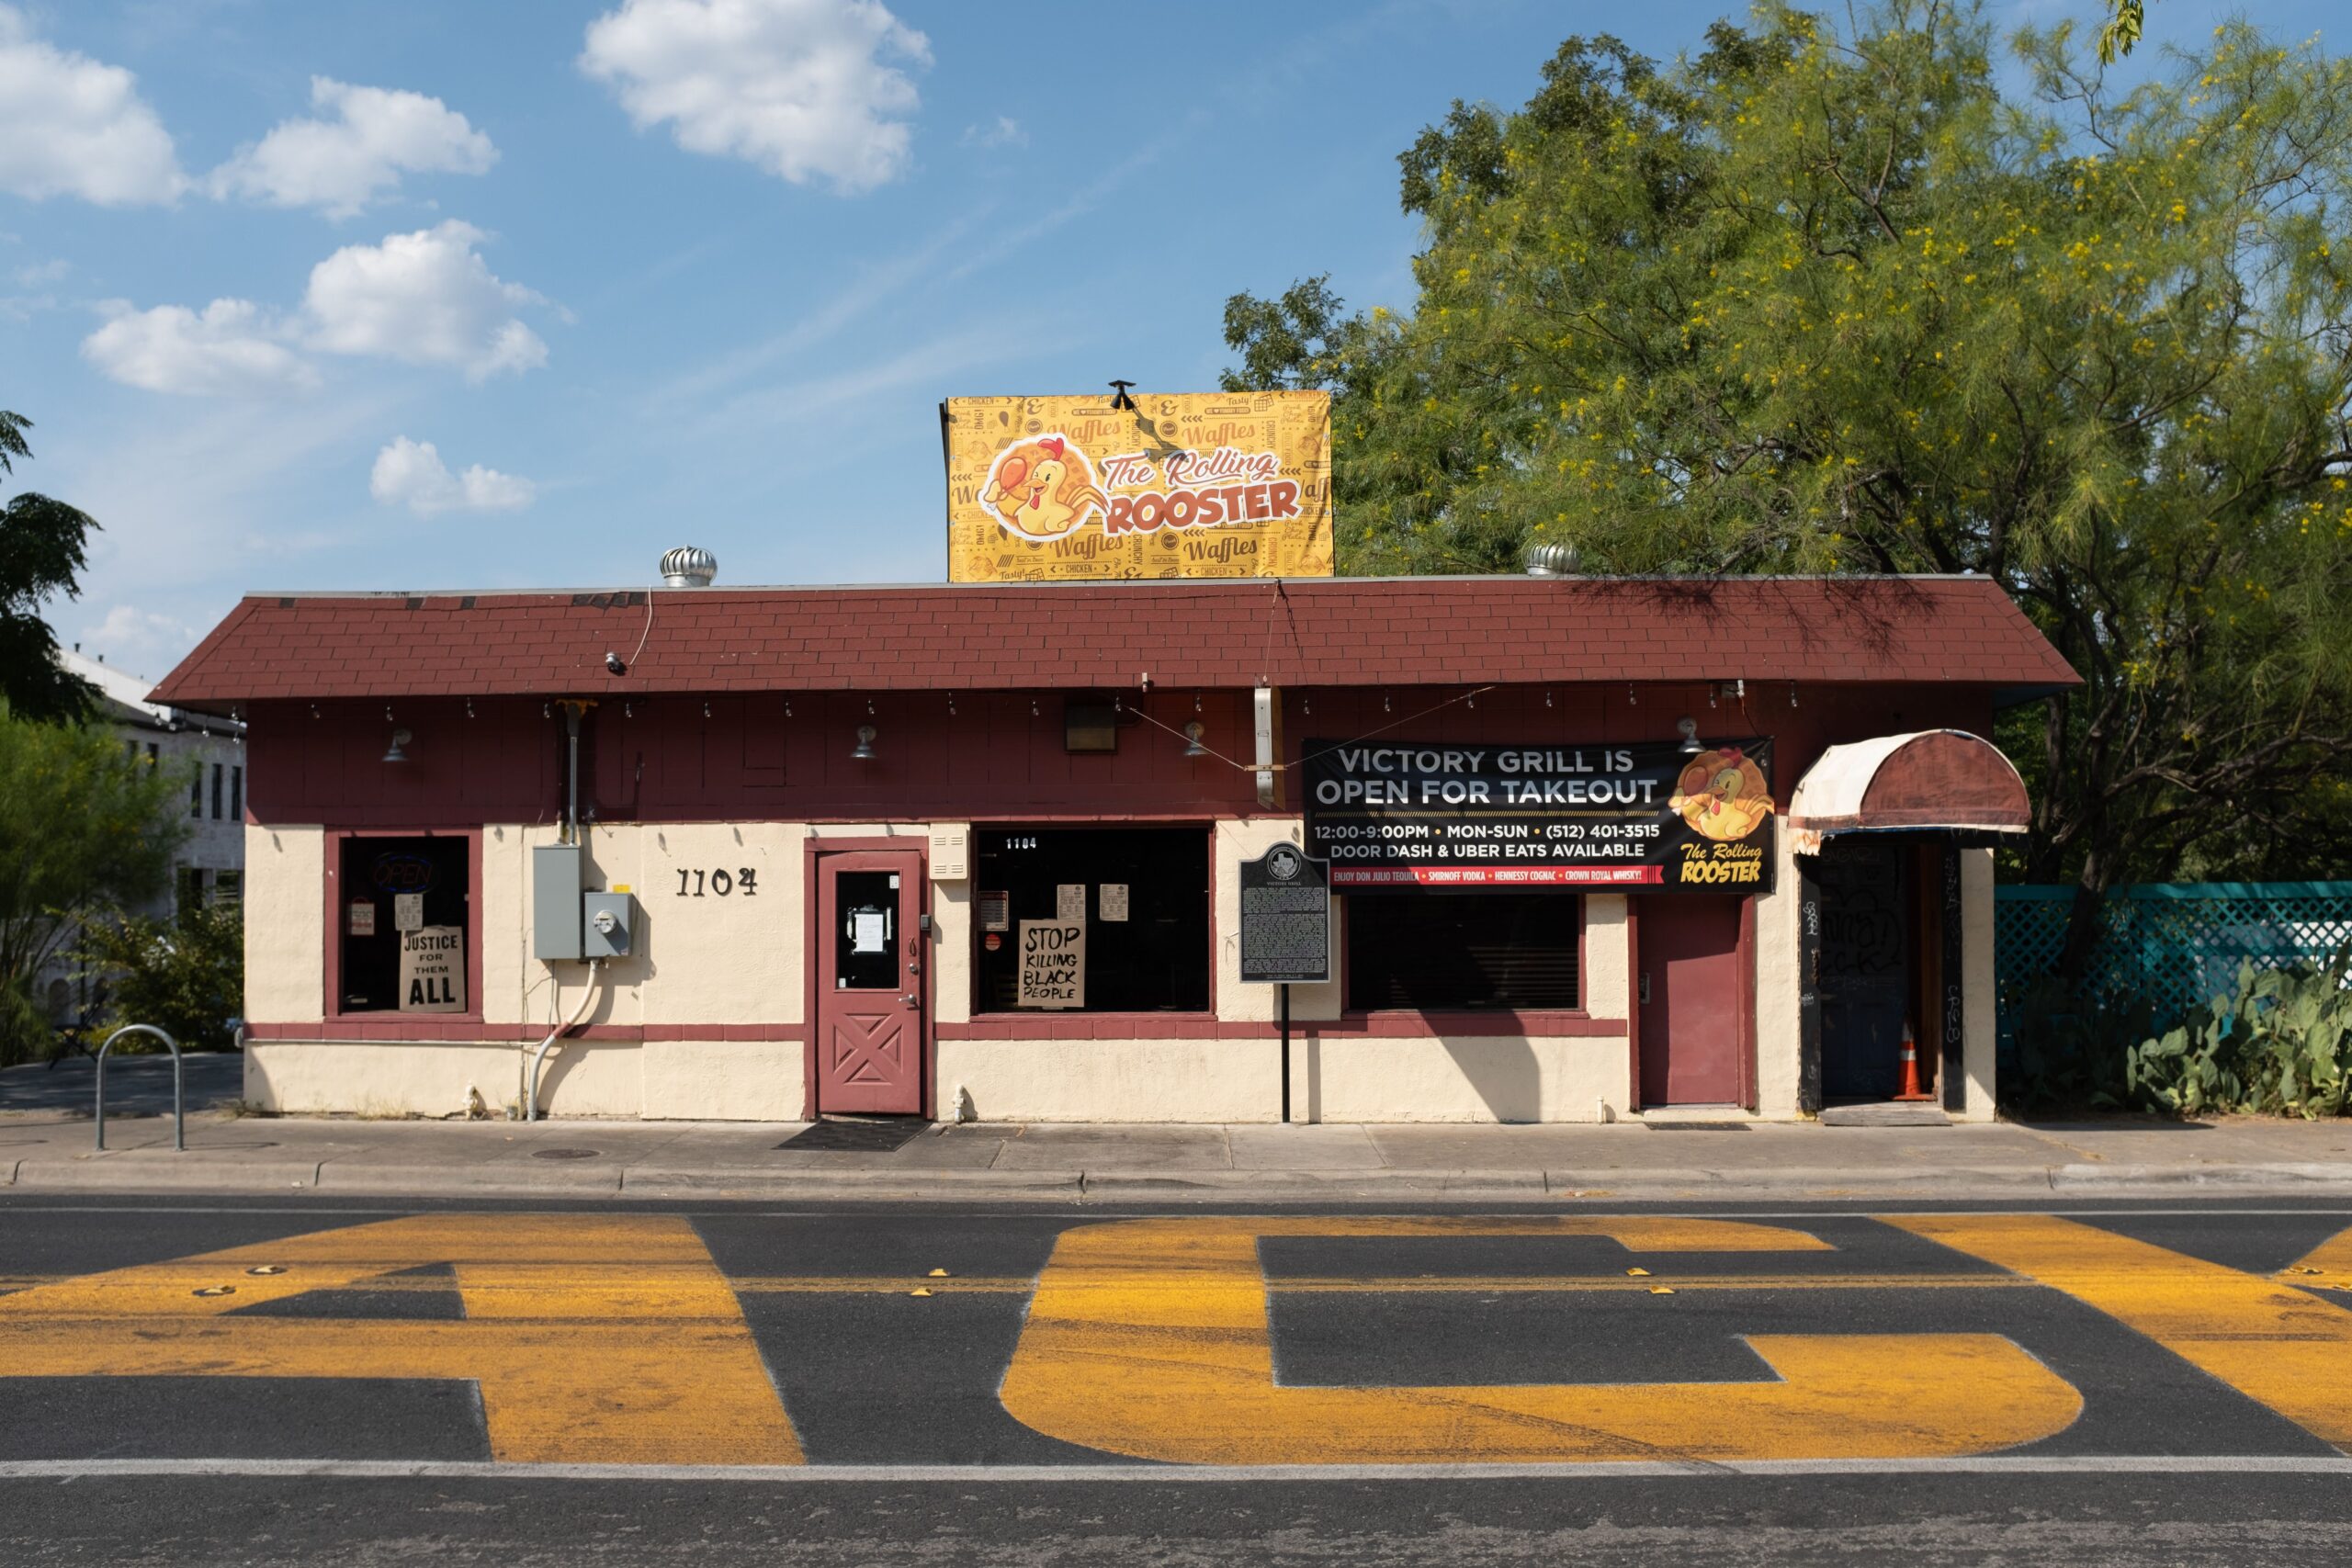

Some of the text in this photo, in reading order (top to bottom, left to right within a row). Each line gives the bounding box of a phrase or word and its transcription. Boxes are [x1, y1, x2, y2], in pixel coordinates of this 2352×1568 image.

[967, 397, 994, 405] CHICKEN
[1227, 393, 1255, 406] Tasty!
[974, 409, 985, 430] OMG!
[1182, 422, 1256, 447] Waffles
[1266, 420, 1277, 449] CRUNCHY
[1105, 450, 1278, 490] The Rolling
[1106, 483, 1298, 534] ROOSTER
[976, 525, 985, 546] OMG!
[1049, 533, 1124, 560] Waffles
[1132, 535, 1143, 565] CRUNCHY
[1182, 536, 1258, 564] Waffles
[1267, 536, 1278, 568] CRUNCHY
[999, 568, 1026, 581] Tasty!
[1066, 564, 1092, 574] CHICKEN
[1200, 567, 1227, 576] CHICKEN
[1337, 749, 1634, 773] VICTORY GRILL IS
[1316, 779, 1657, 805] OPEN FOR TAKEOUT
[1315, 824, 1660, 840] 12:00-9:00PM MON-SUN (512) 401-3515
[1006, 837, 1037, 850] 1104
[1331, 843, 1645, 858] DOOR DASH & UBER EATS AVAILABLE
[1680, 842, 1763, 863] The Rolling
[373, 863, 432, 885] OPEN
[676, 867, 759, 897] 1104
[1334, 870, 1642, 882] ENJOY DON JULIO TEQUILA SMIRNOFF VODKA HENNESSY COGNAC CROWN ROYAL WHISKY!
[1680, 860, 1762, 884] ROOSTER
[404, 934, 458, 952] JUSTICE
[1024, 926, 1081, 953] STOP
[419, 953, 444, 962] FOR
[1025, 953, 1078, 969] KILLING
[413, 965, 449, 975] THEM
[1023, 970, 1077, 987] BLACK
[409, 976, 457, 1006] ALL
[1023, 987, 1076, 1000] PEOPLE
